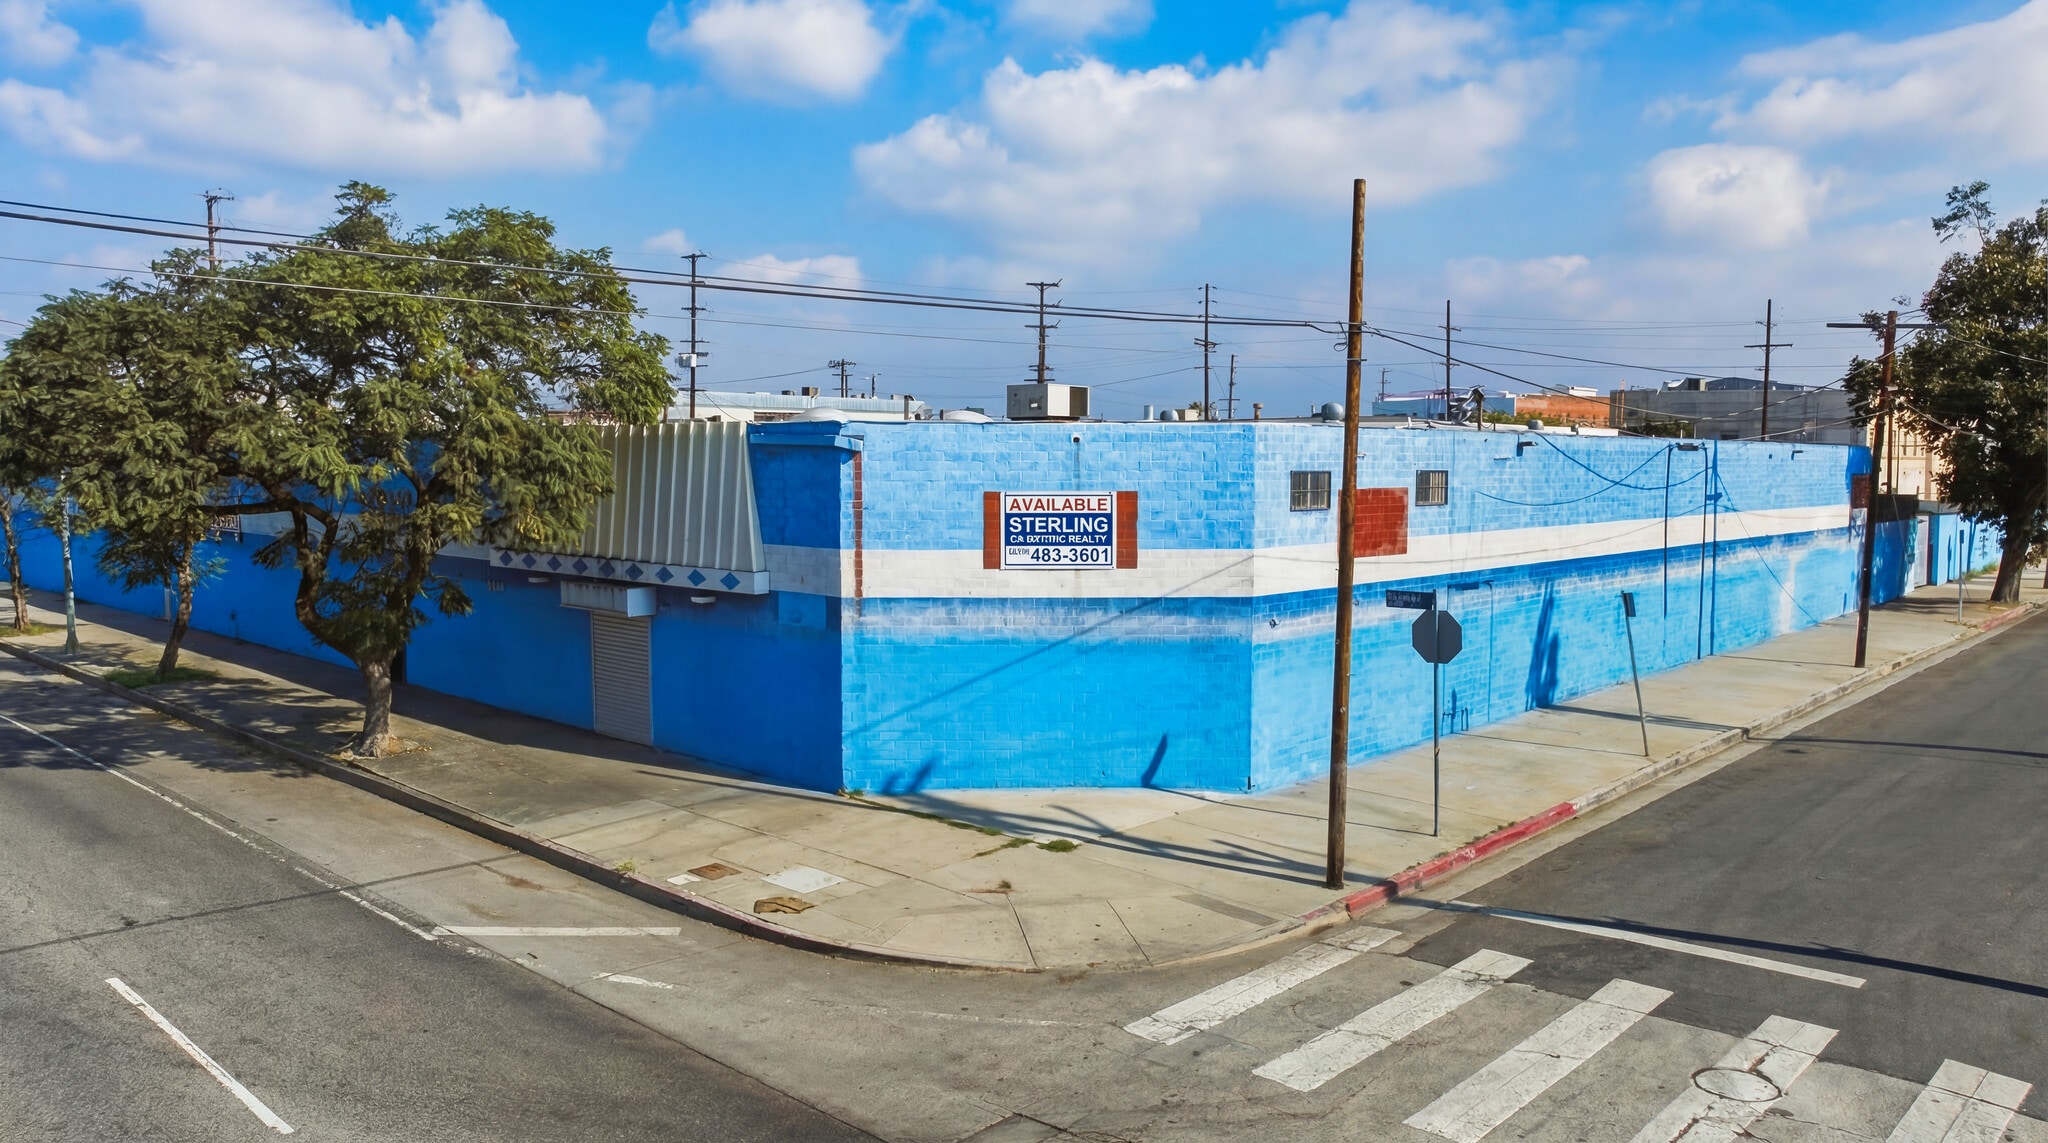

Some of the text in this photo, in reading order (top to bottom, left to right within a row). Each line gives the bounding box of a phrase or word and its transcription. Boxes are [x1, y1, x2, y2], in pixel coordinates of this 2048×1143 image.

[1009, 498, 1108, 512] AVAILABLE
[1009, 516, 1108, 533] STERLING
[1068, 534, 1108, 543] REALTY
[1030, 547, 1108, 563] 483-3601
